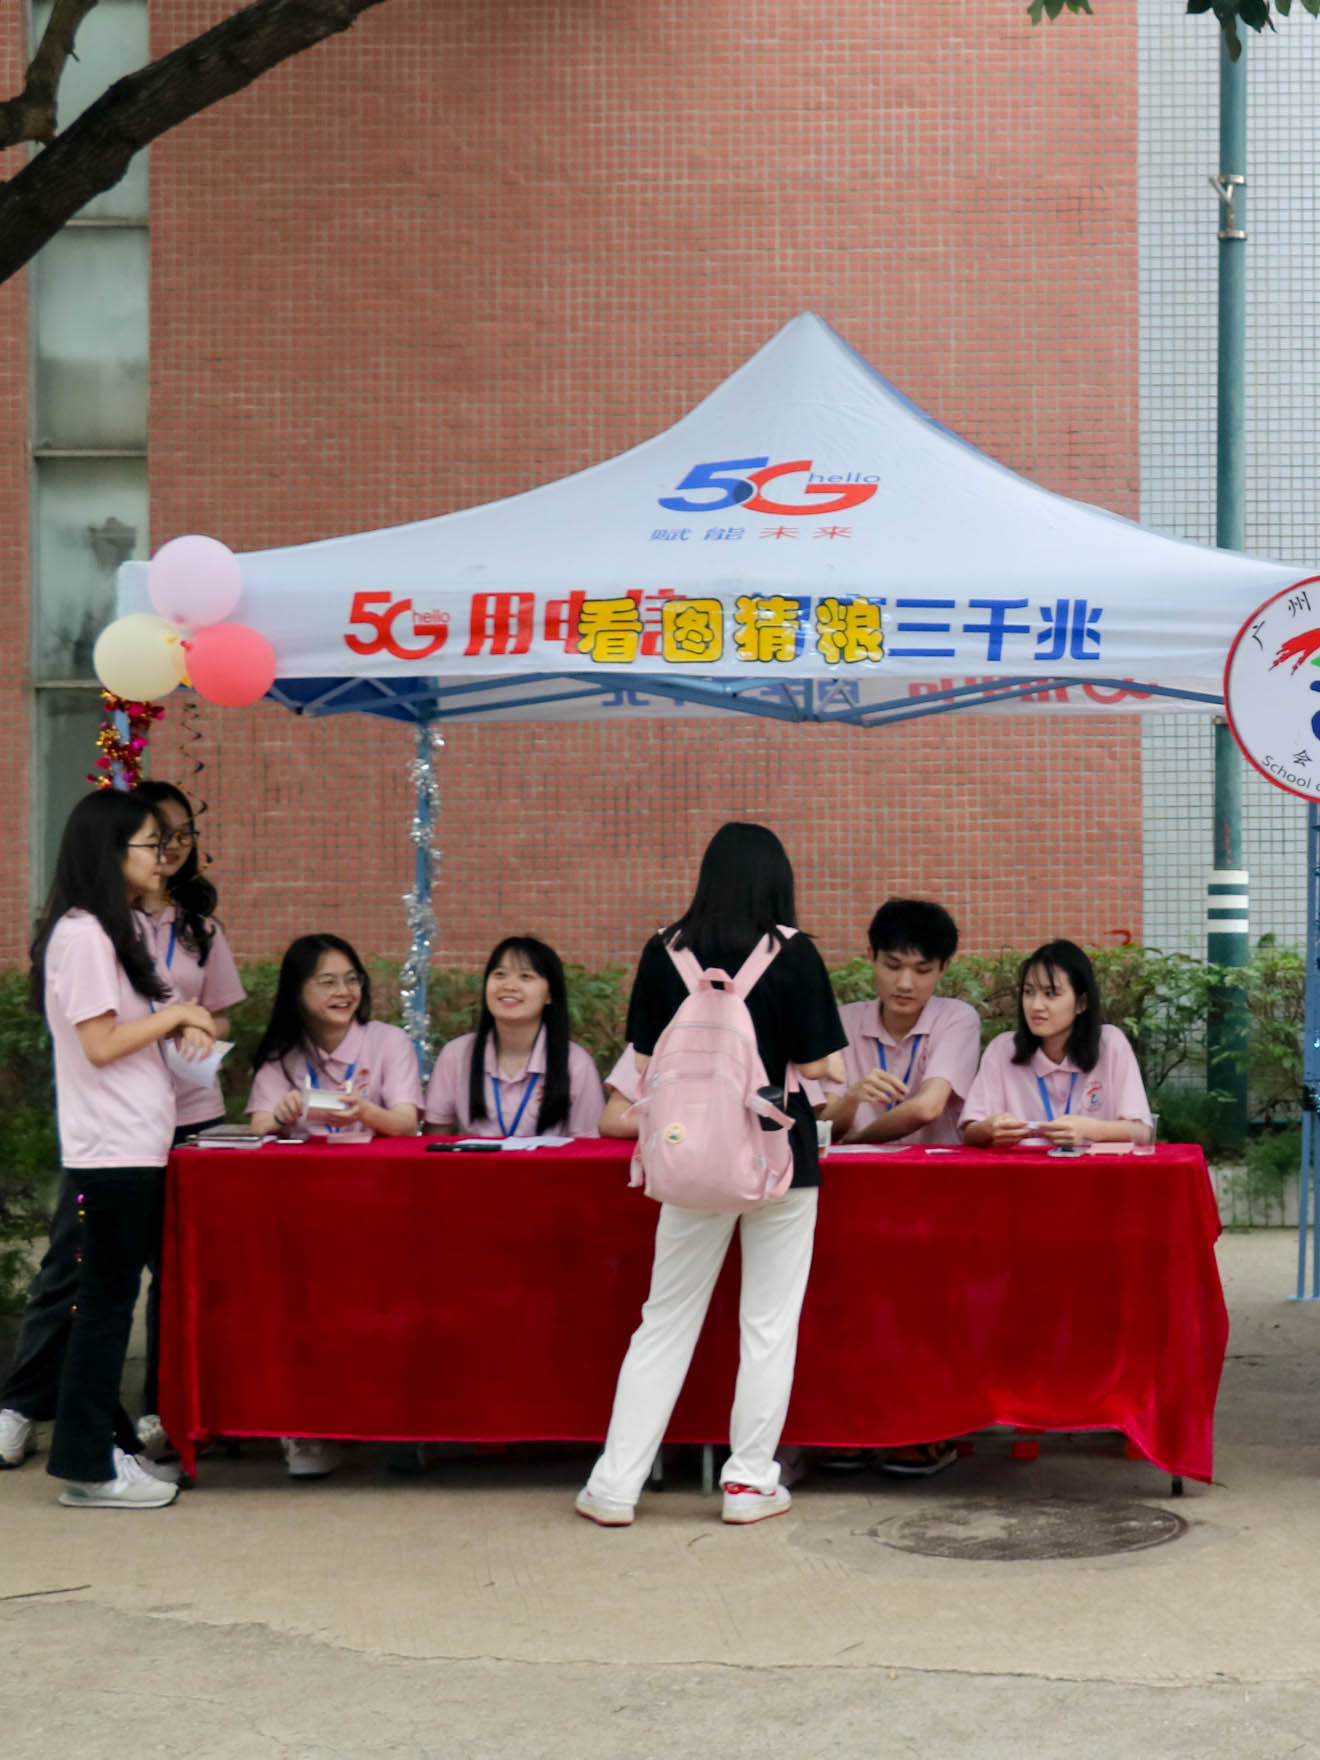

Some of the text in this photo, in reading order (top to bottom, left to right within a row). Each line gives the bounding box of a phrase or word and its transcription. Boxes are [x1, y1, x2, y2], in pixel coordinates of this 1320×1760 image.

[657, 456, 878, 516] 5G
[808, 472, 880, 483] hello
[344, 591, 448, 660] 5G
[412, 609, 450, 622] hello
[576, 596, 885, 664] 看图猜粮
[1262, 755, 1312, 790] School
